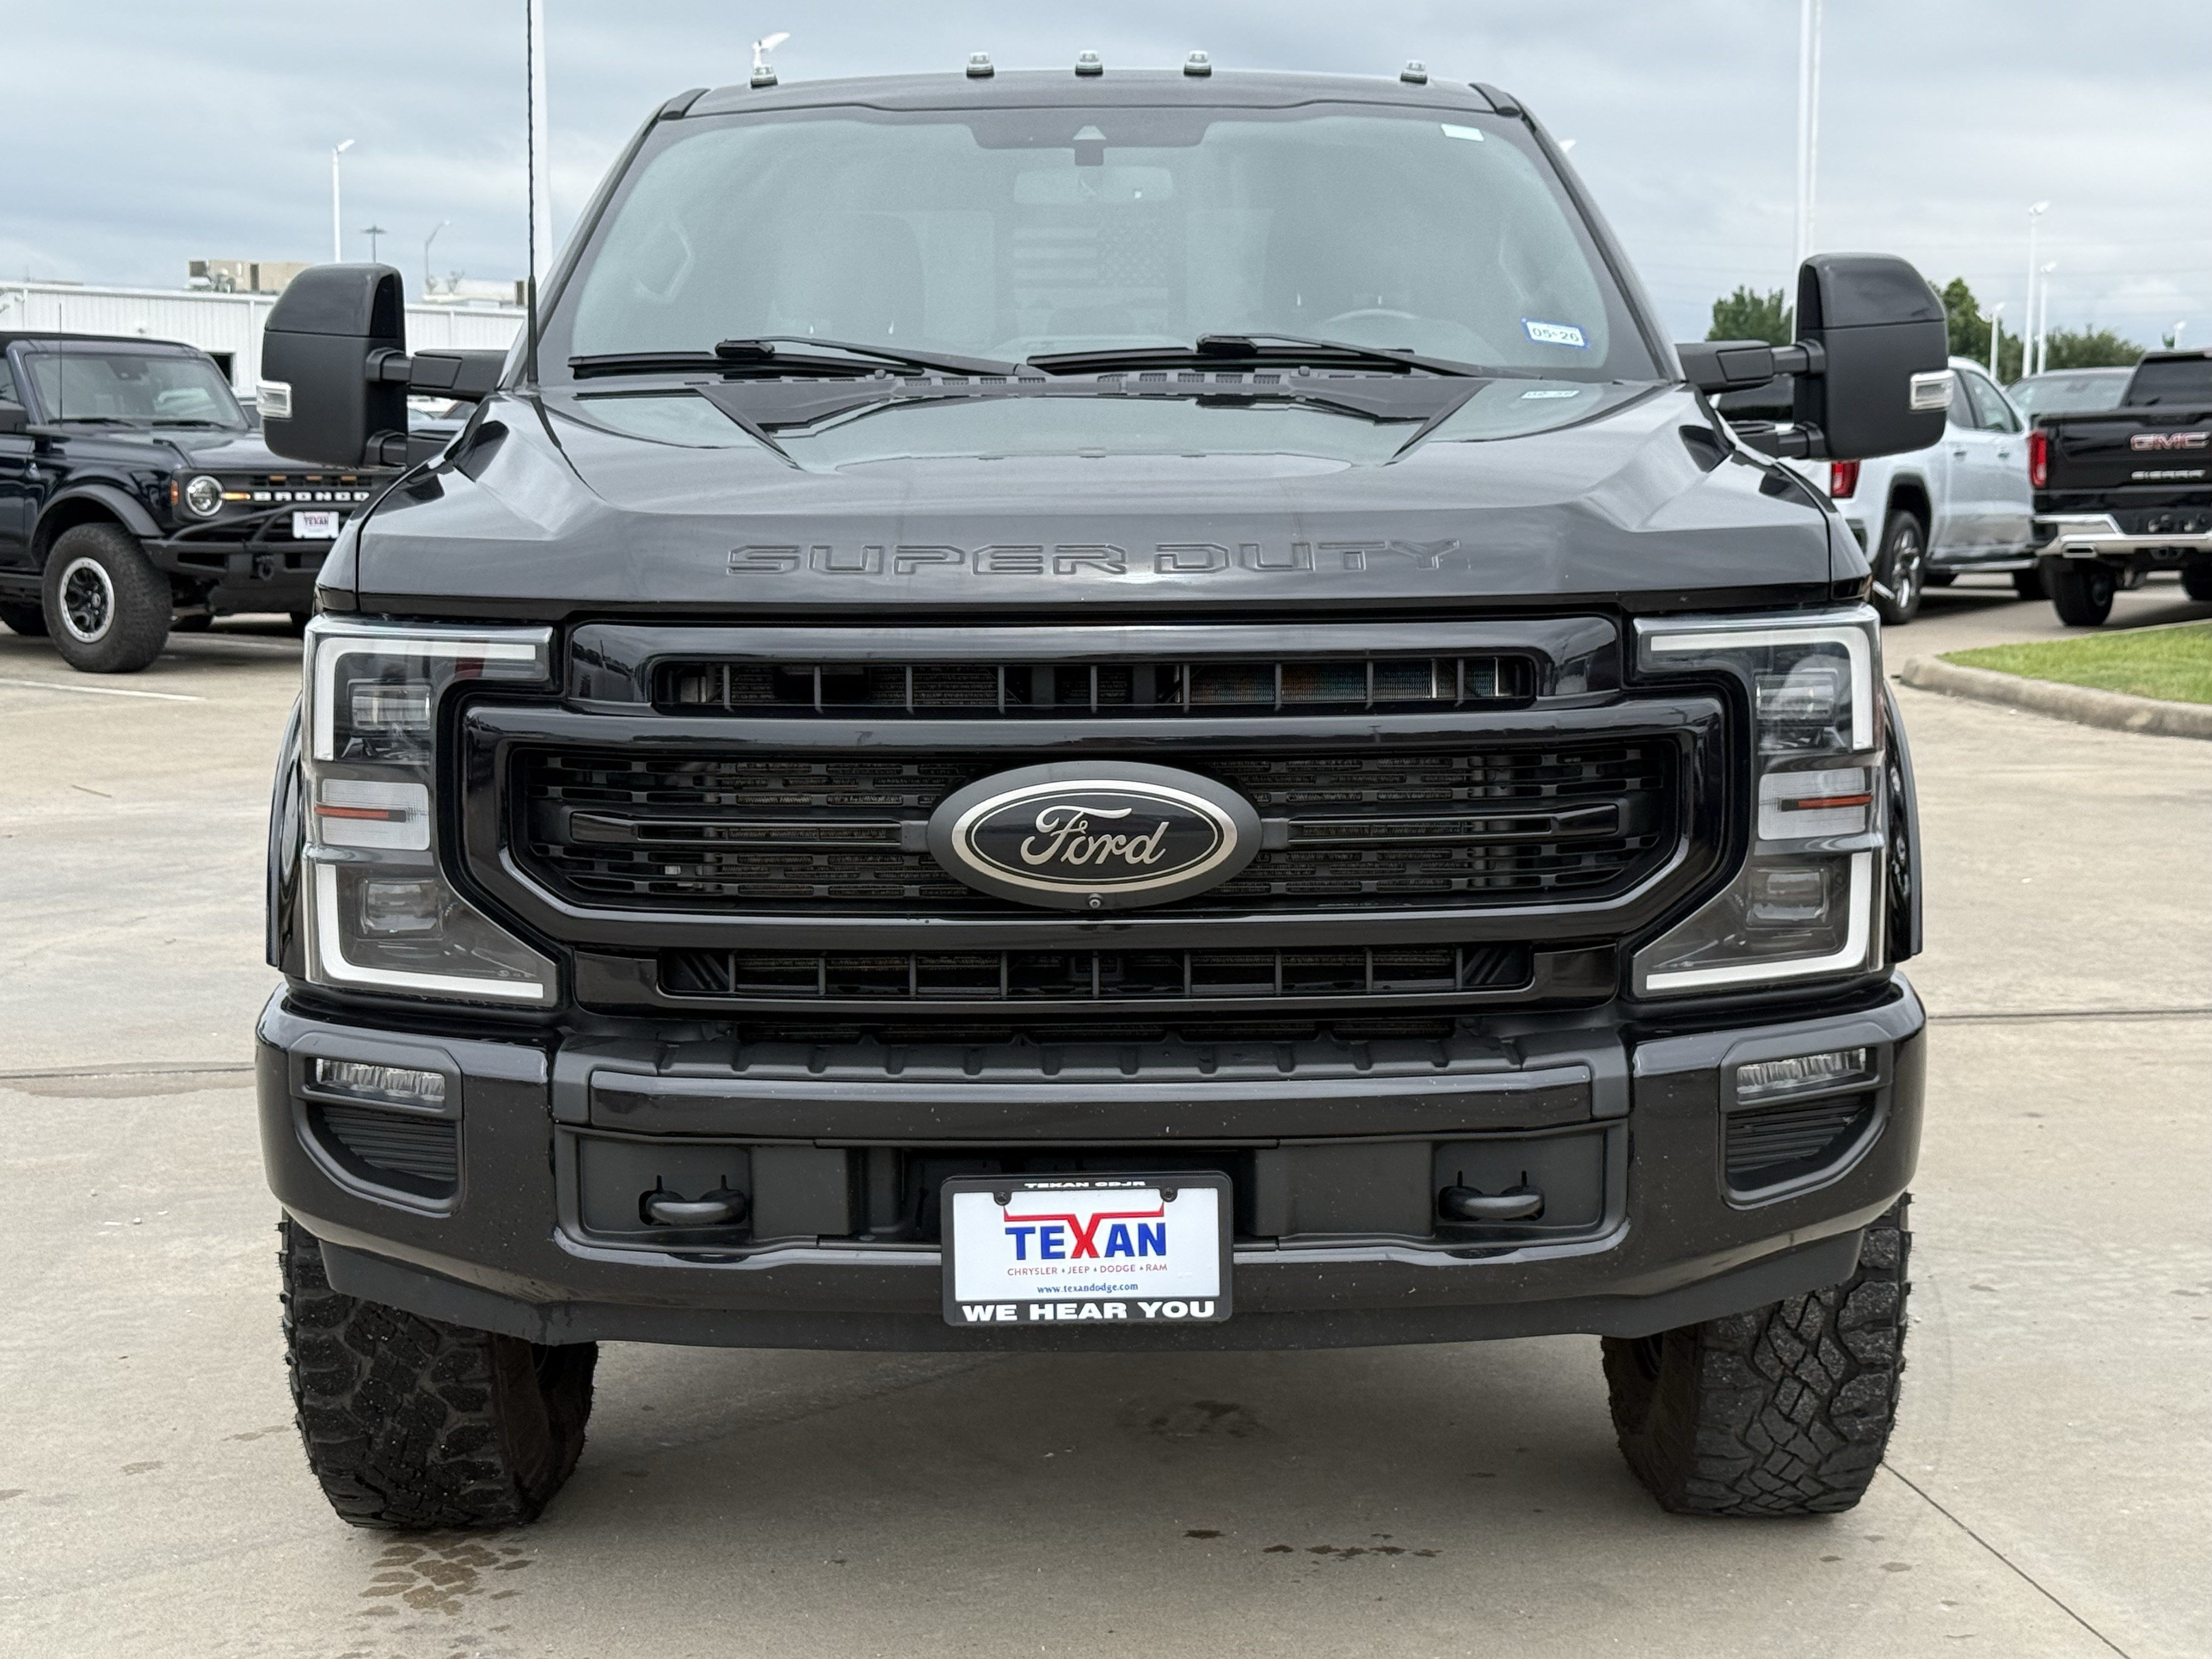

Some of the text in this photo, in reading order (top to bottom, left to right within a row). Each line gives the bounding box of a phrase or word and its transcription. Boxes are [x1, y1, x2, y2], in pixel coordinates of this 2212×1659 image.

[2130, 432, 2211, 451] GMC
[726, 539, 1460, 575] SUPER DUTY
[1020, 804, 1170, 865] Ford
[1005, 1214, 1166, 1260] TEXAN
[1007, 1263, 1167, 1276] CHRYSLER JEEP DODGE RAM
[1037, 1283, 1138, 1293] www.texandodge.com
[962, 1301, 1215, 1322] WE HEAR YOU
